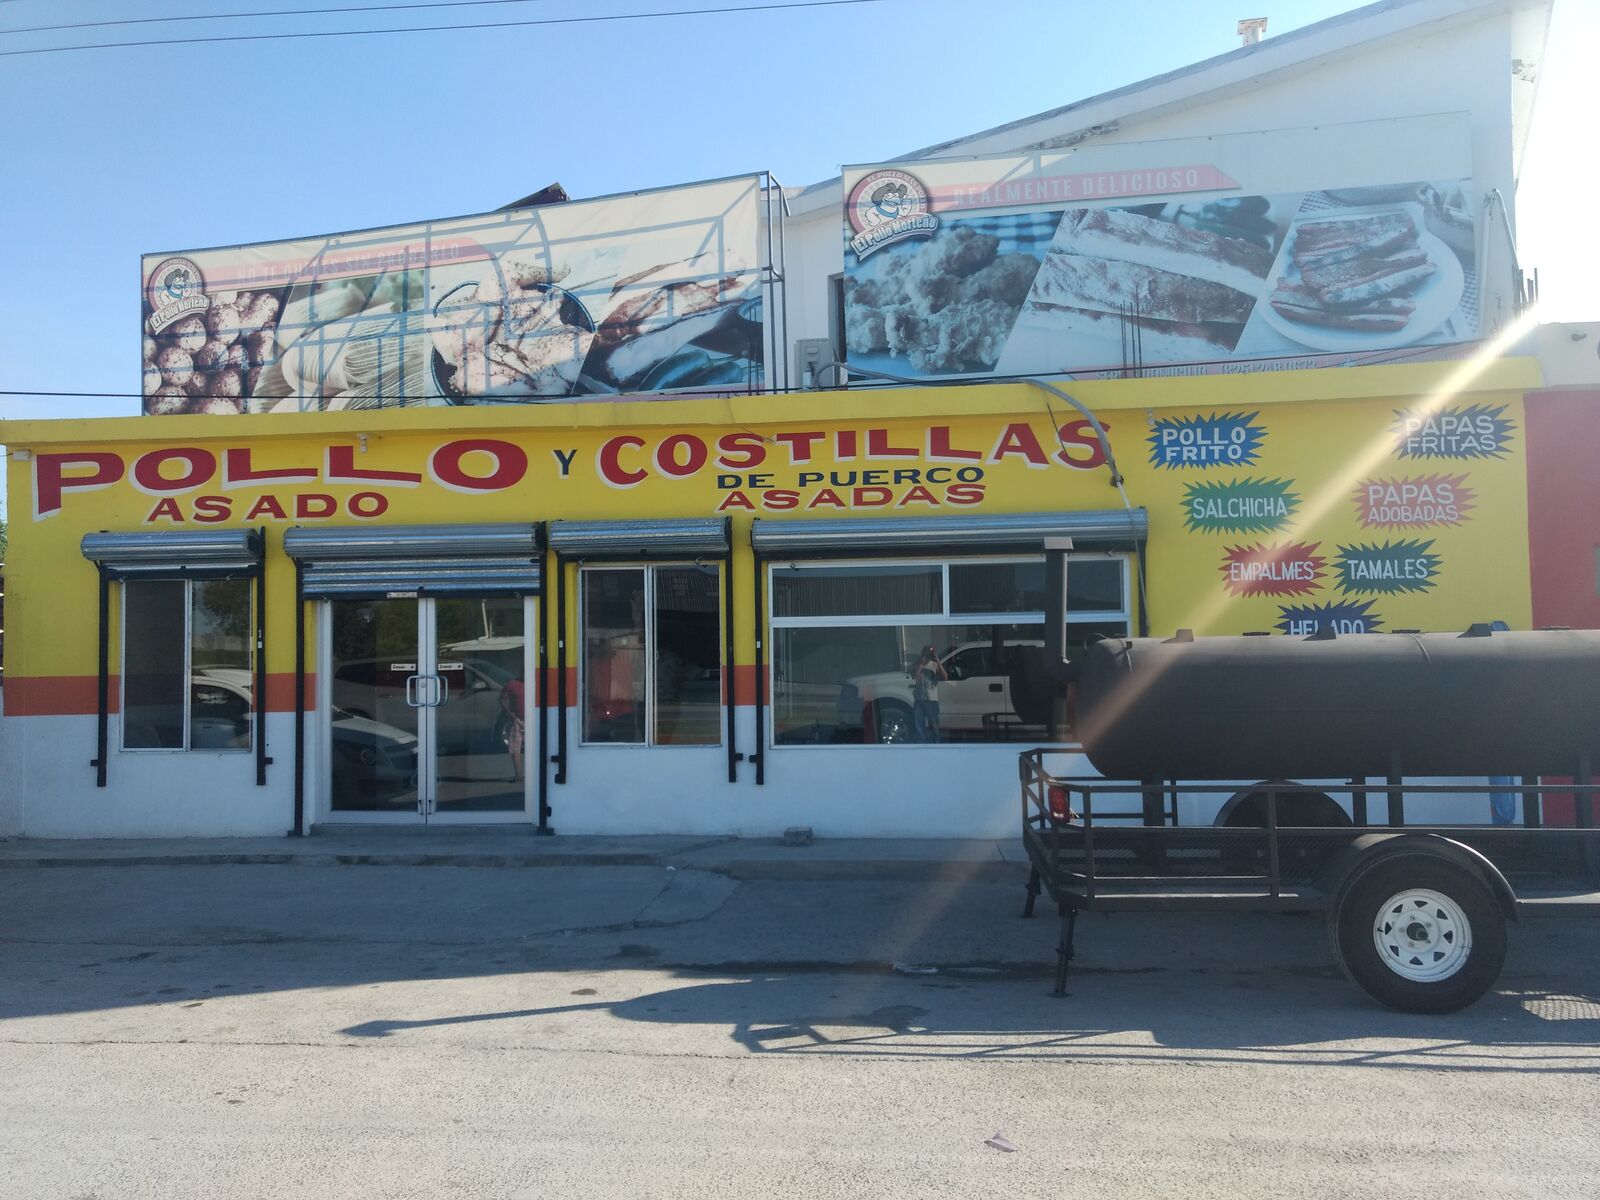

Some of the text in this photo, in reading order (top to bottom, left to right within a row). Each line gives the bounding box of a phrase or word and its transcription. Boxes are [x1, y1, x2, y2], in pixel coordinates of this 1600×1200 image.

[953, 169, 1199, 205] REALMENTE DELICIOSO
[865, 224, 894, 246] Pollo
[160, 303, 179, 321] Pollo
[1162, 426, 1246, 446] POLLO
[1405, 416, 1495, 436] PAPAS
[1166, 444, 1242, 461] FRITO
[1407, 435, 1497, 453] FRITAS
[34, 419, 1112, 519] POLLO Y COSTILLAS
[717, 466, 985, 490] DE PUERCO
[719, 483, 985, 511] ASADAS
[1368, 483, 1454, 506] PAPAS
[148, 492, 390, 522] ASADO
[1192, 496, 1288, 520] SALCHICHA
[1367, 505, 1459, 523] ADOBADAS
[1230, 560, 1315, 582] EMPALMES
[1347, 558, 1428, 580] TAMALES
